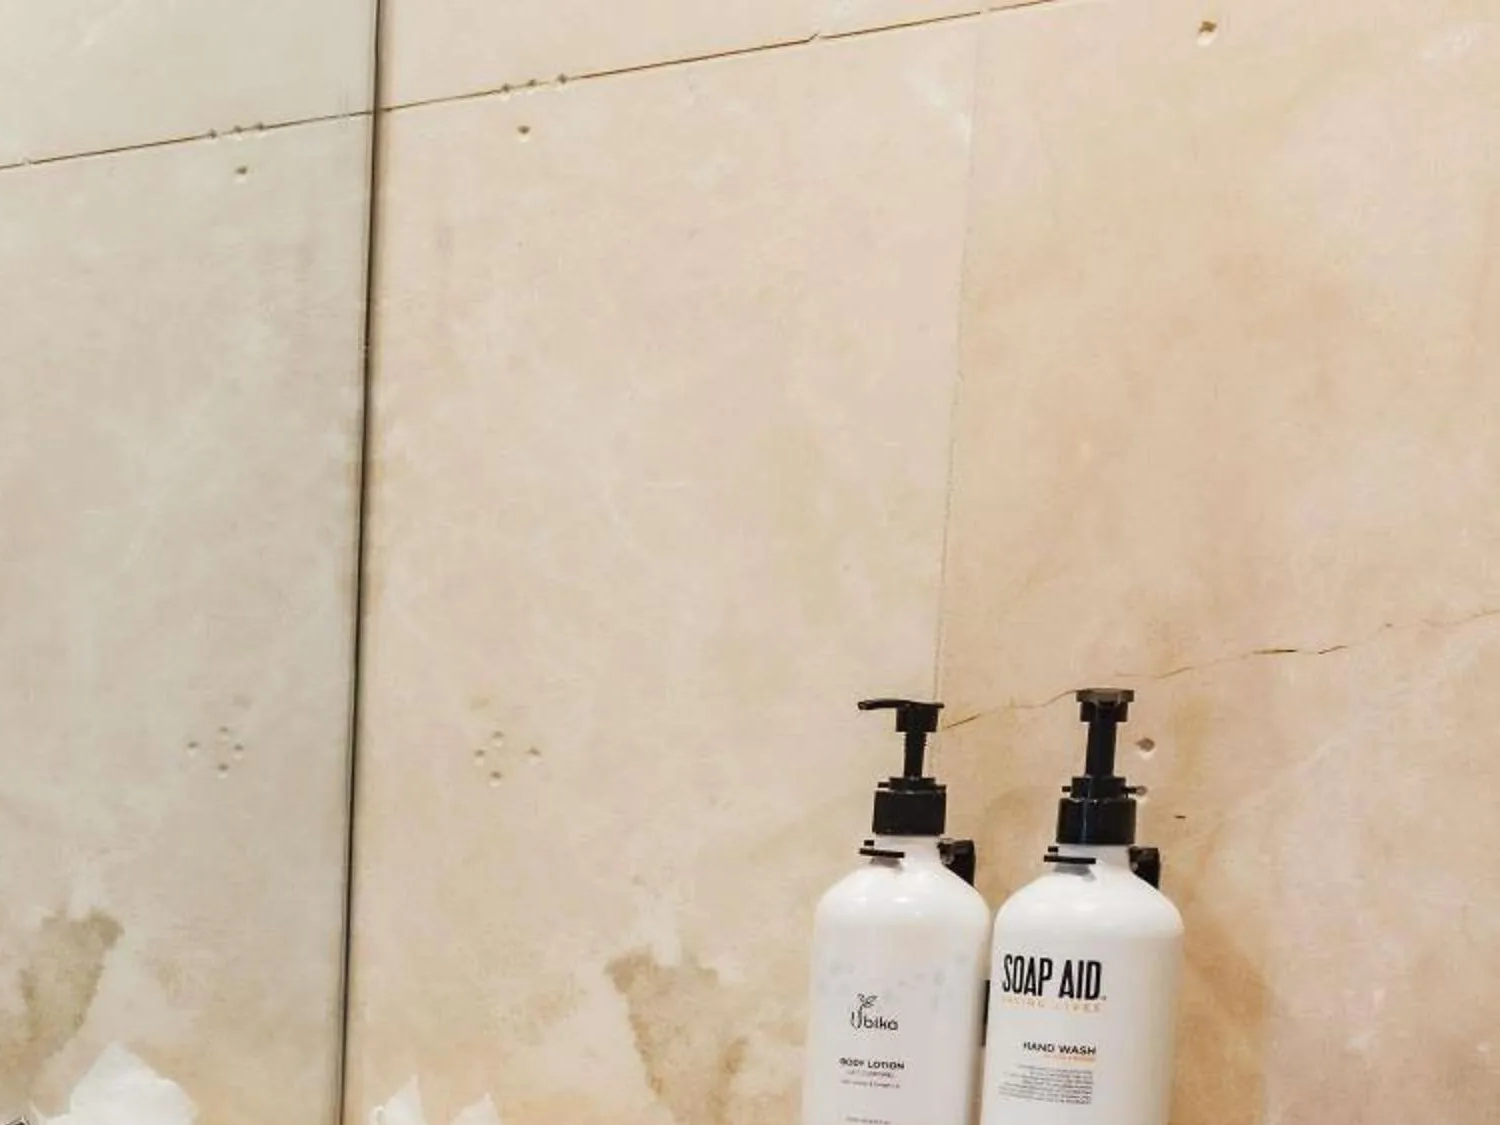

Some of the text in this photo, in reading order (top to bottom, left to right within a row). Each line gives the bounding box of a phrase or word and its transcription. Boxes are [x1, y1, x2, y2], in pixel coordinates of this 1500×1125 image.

[1002, 954, 1102, 1001] SOAP AID
[1023, 1041, 1097, 1056] HAND WASH
[867, 1060, 905, 1070] LOTION
